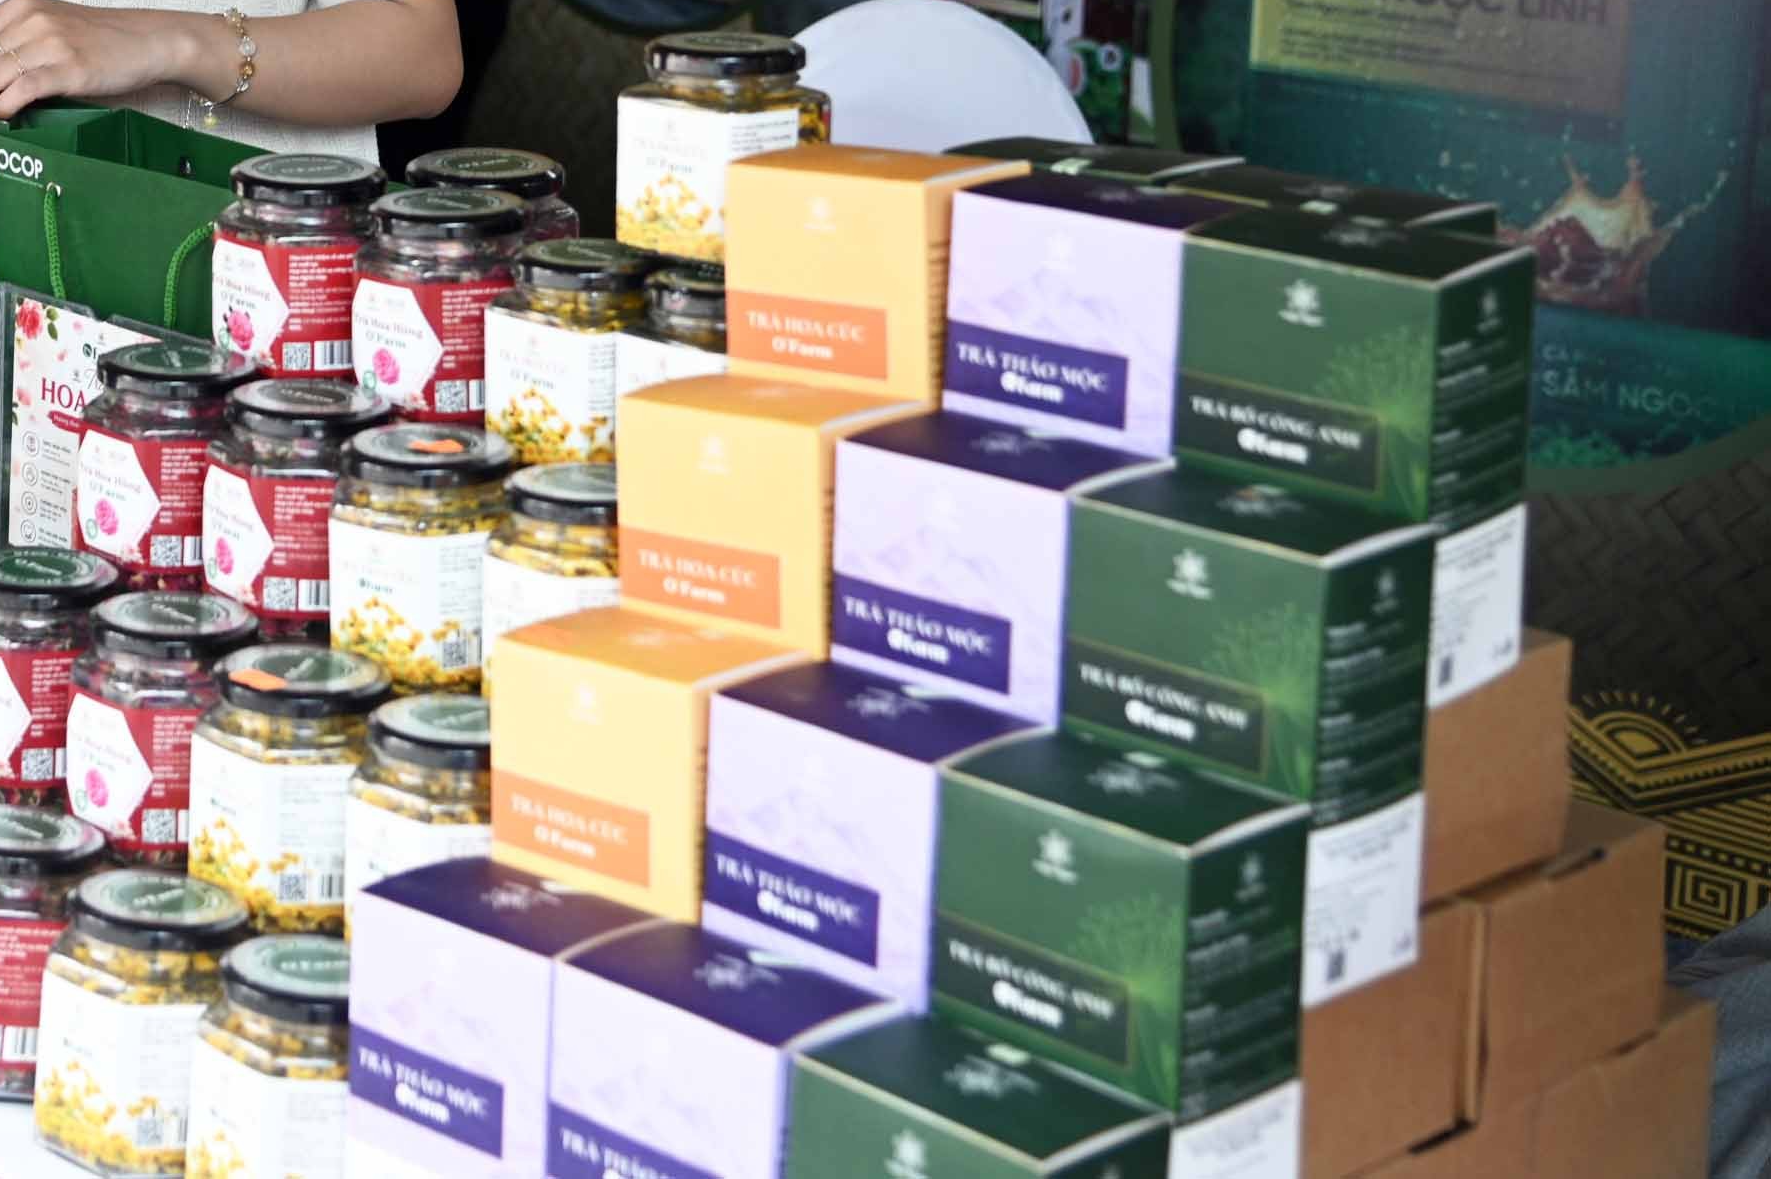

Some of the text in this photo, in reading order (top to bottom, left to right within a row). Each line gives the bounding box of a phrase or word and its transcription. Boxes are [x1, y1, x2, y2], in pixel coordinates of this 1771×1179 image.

[745, 310, 780, 331] TRÀ
[784, 315, 824, 336] HOA
[957, 342, 995, 368] TRÀ
[41, 378, 86, 412] HOA
